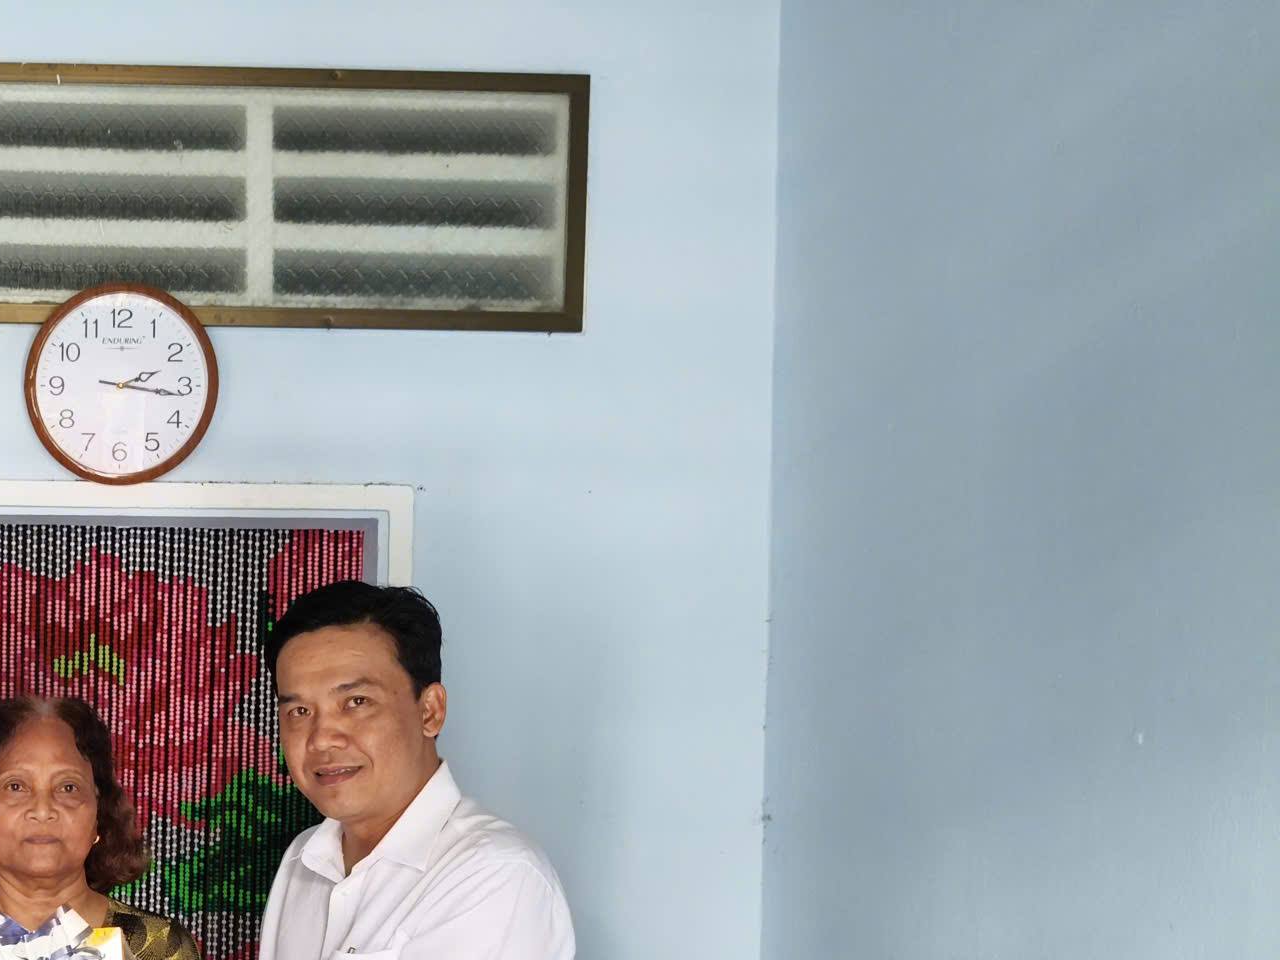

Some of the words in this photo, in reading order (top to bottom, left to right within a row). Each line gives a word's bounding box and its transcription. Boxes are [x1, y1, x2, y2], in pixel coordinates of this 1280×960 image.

[111, 308, 133, 328] 12
[83, 318, 99, 339] 11
[150, 318, 157, 339] 1
[101, 336, 144, 345] ENDURING
[58, 342, 81, 362] 10
[167, 342, 184, 362] 2
[48, 375, 65, 396] 9
[177, 376, 193, 396] 3
[58, 408, 75, 429] 8
[166, 409, 182, 429] 4
[81, 432, 96, 452] 7
[111, 441, 128, 461] 6
[144, 432, 160, 452] 5
